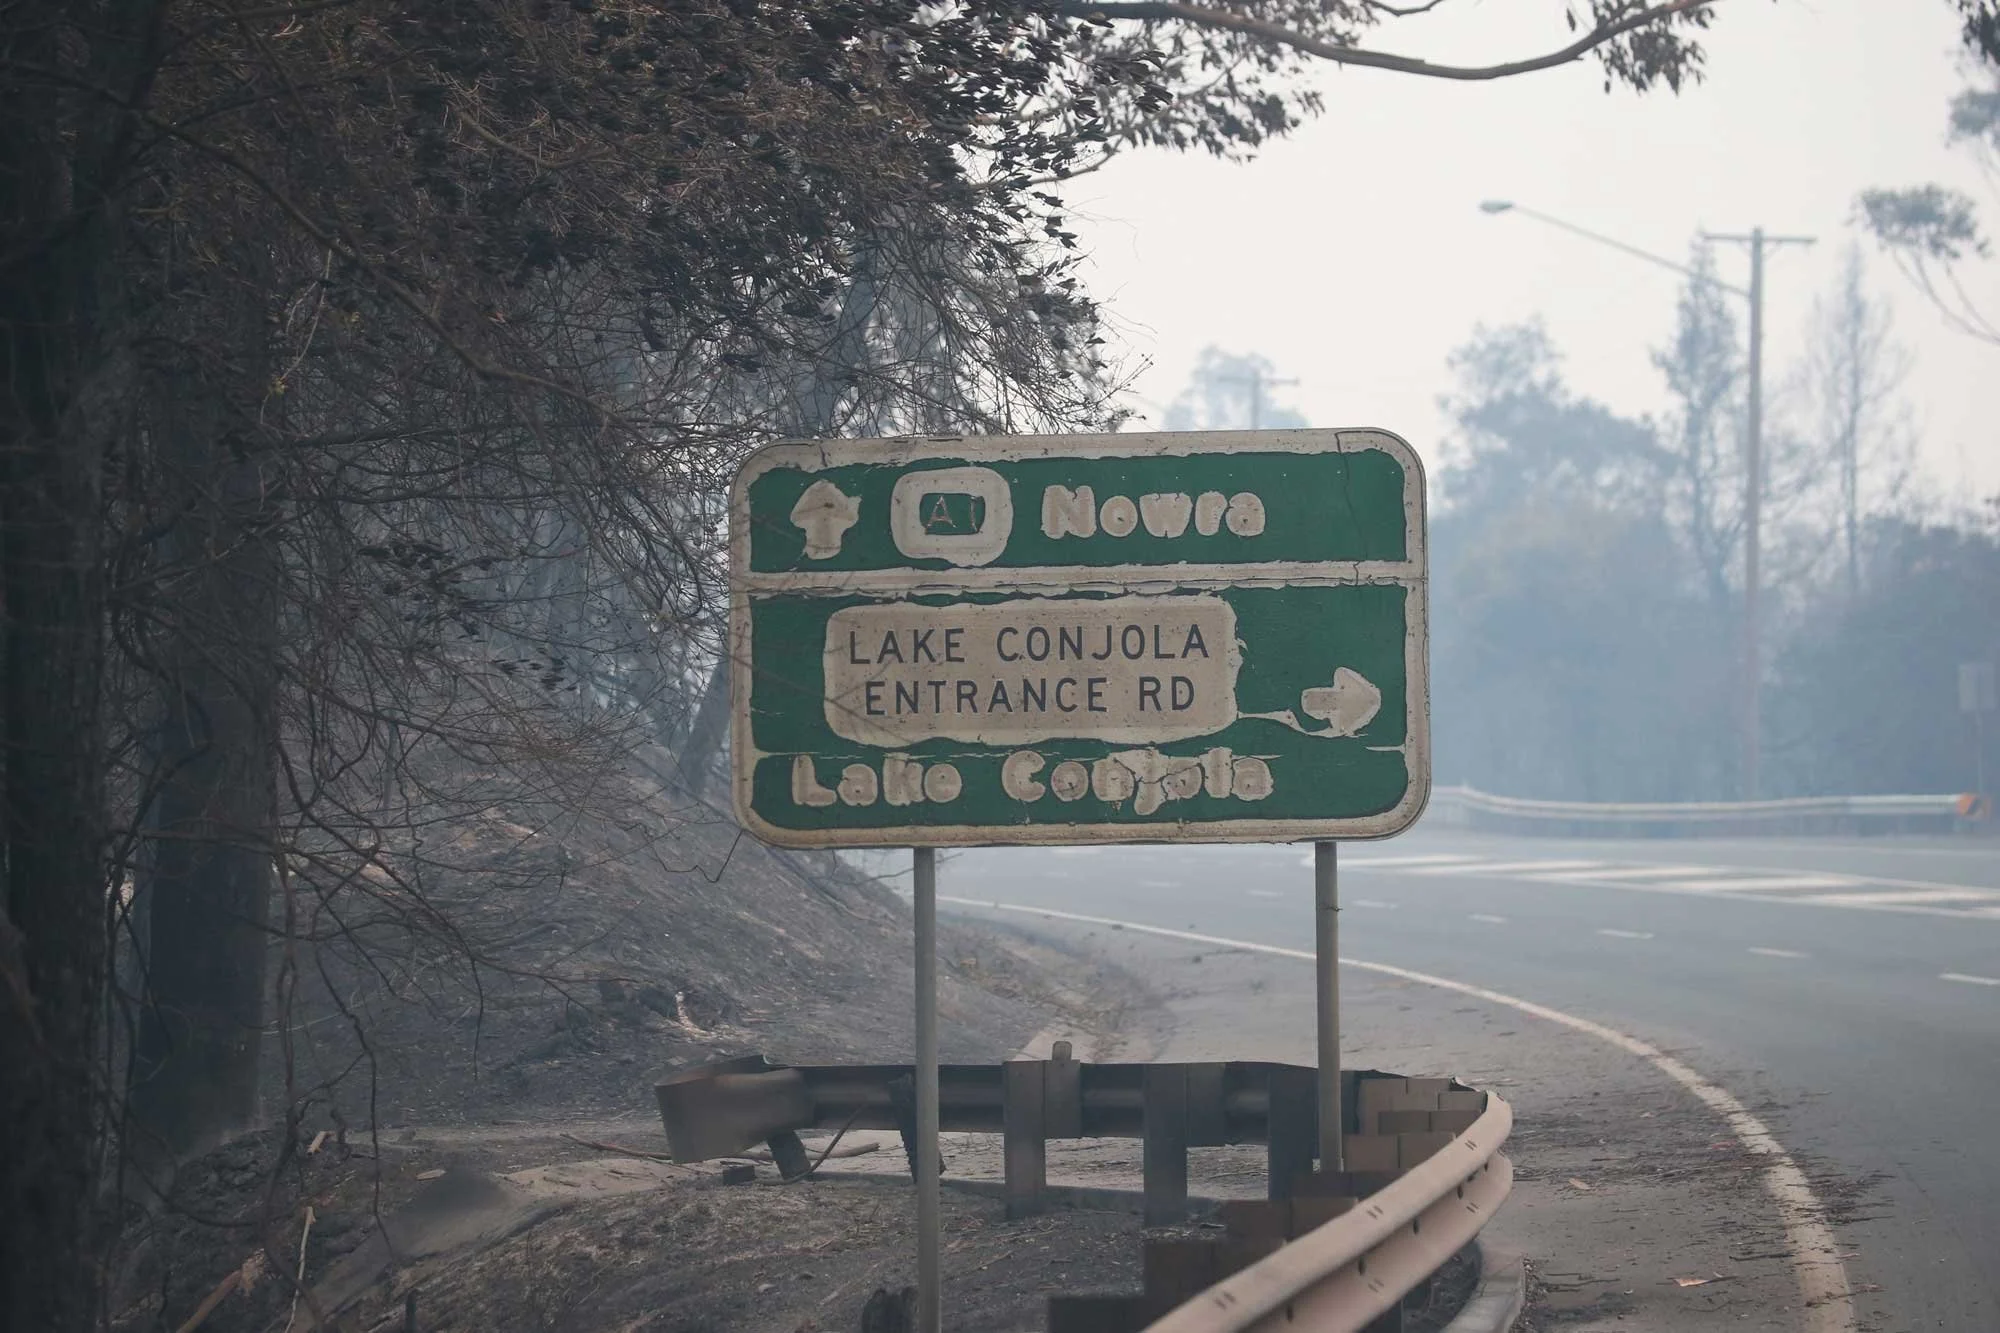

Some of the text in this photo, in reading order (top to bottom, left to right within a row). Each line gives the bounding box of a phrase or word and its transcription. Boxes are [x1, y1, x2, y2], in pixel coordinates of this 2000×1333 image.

[1041, 485, 1266, 539] Nowra
[849, 623, 1210, 665] LAKE CONJOLA
[865, 675, 1196, 716] ENTRANCE RD
[791, 752, 963, 807] Lake
